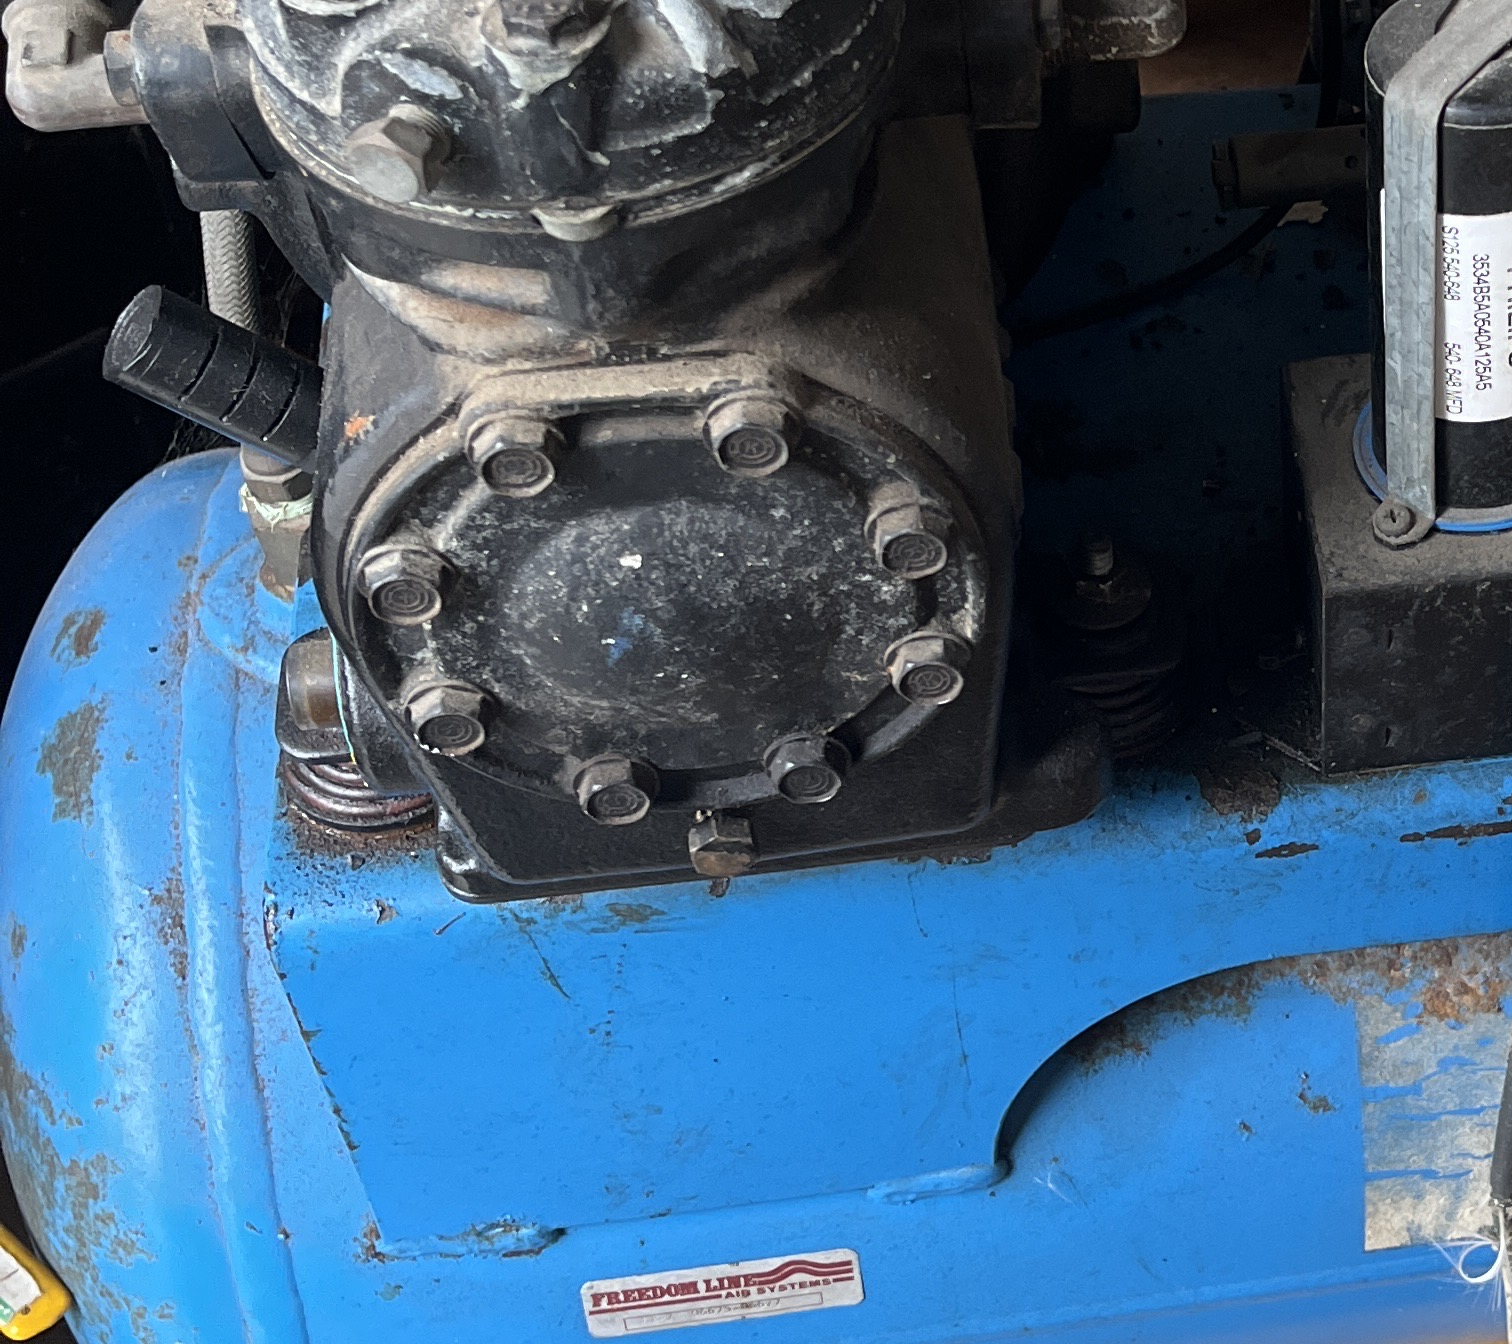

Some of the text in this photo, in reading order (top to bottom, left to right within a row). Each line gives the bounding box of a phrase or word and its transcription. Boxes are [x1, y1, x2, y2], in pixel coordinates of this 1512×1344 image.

[1442, 225, 1459, 255] S125
[1443, 256, 1461, 302] 540-648
[1446, 388, 1463, 415] MFD
[590, 1273, 756, 1308] FREEDOM LINE
[756, 1277, 832, 1296] SYSTEMS
